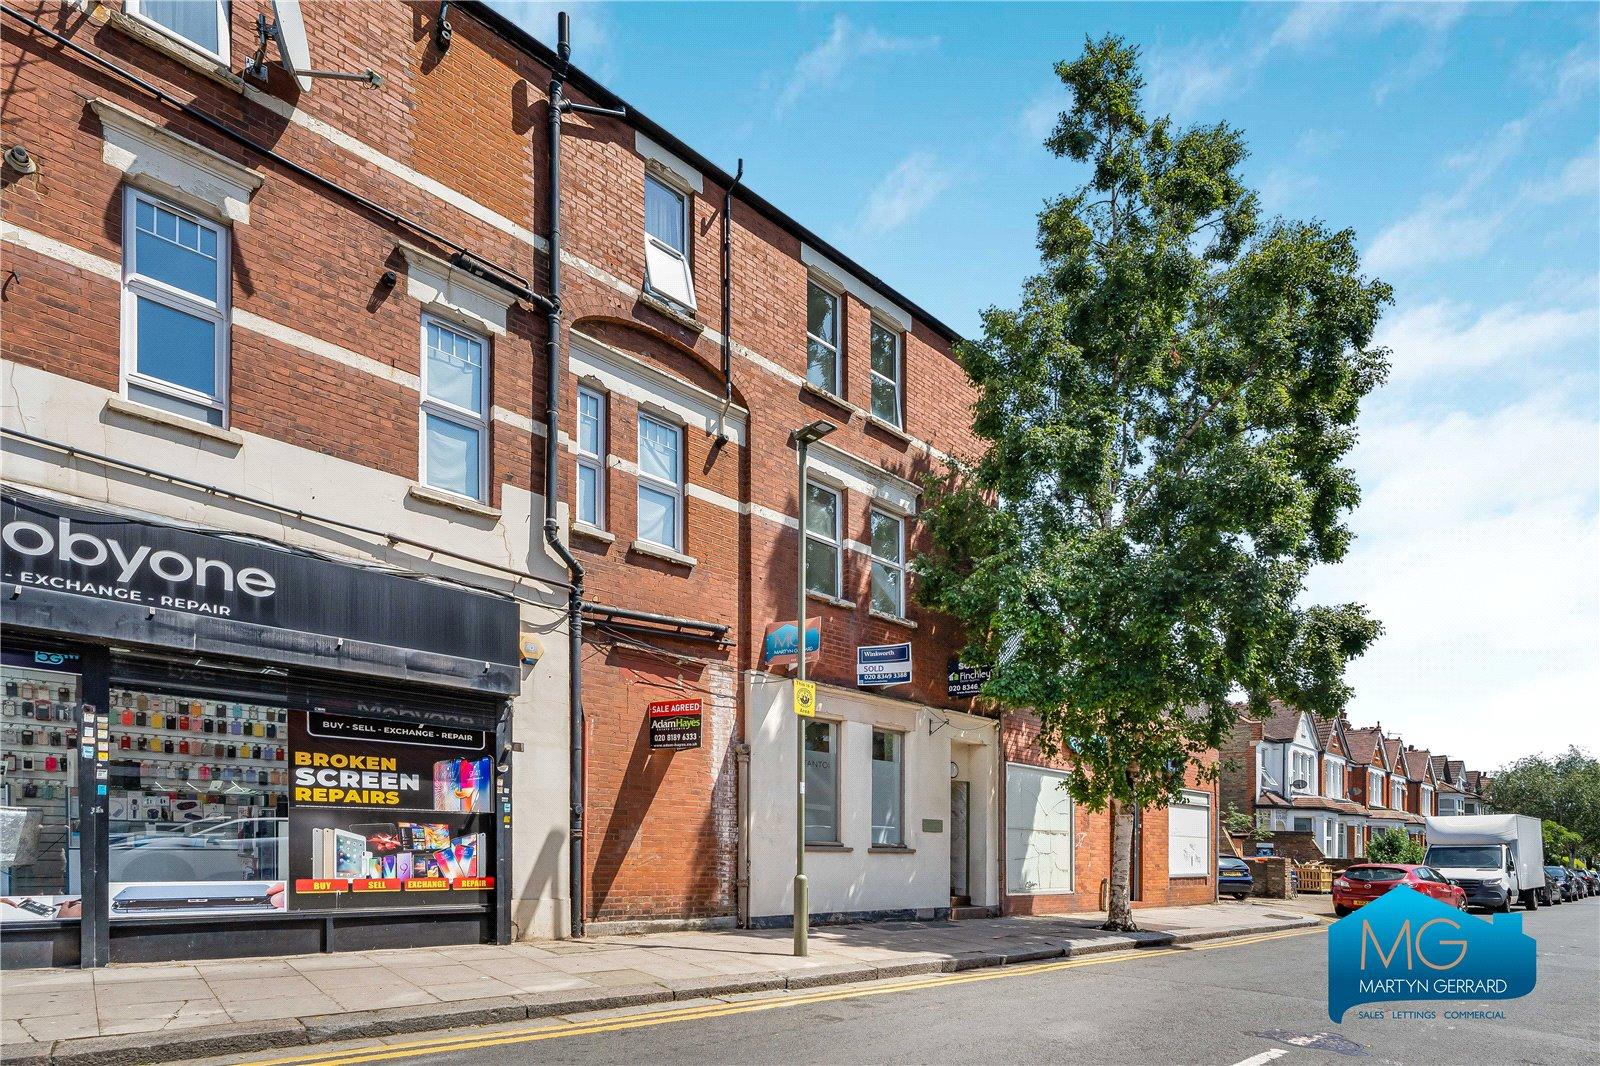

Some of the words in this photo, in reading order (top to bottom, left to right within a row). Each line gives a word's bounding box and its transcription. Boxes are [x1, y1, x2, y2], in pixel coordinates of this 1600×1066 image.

[20, 572, 142, 602] EXCHANGE
[160, 595, 232, 617] REPAIR
[864, 649, 895, 658] Winkworth
[863, 665, 885, 673] SOLD
[959, 668, 991, 681] Finchley
[962, 683, 979, 691] 8346
[652, 704, 670, 713] SALE
[670, 703, 700, 712] AGREED
[322, 721, 344, 730] BUY
[352, 723, 376, 733] SELL
[383, 726, 434, 738] EXCHANGE
[441, 732, 474, 742] REPAIR
[681, 732, 697, 741] 6333
[294, 751, 397, 771] BROKEN
[295, 767, 420, 791] SCREEN
[294, 787, 400, 805] REPAIRS
[313, 882, 332, 890] BUY
[367, 881, 387, 889] SELL
[407, 880, 447, 889] EXCHANGE
[461, 880, 487, 888] REPAIR
